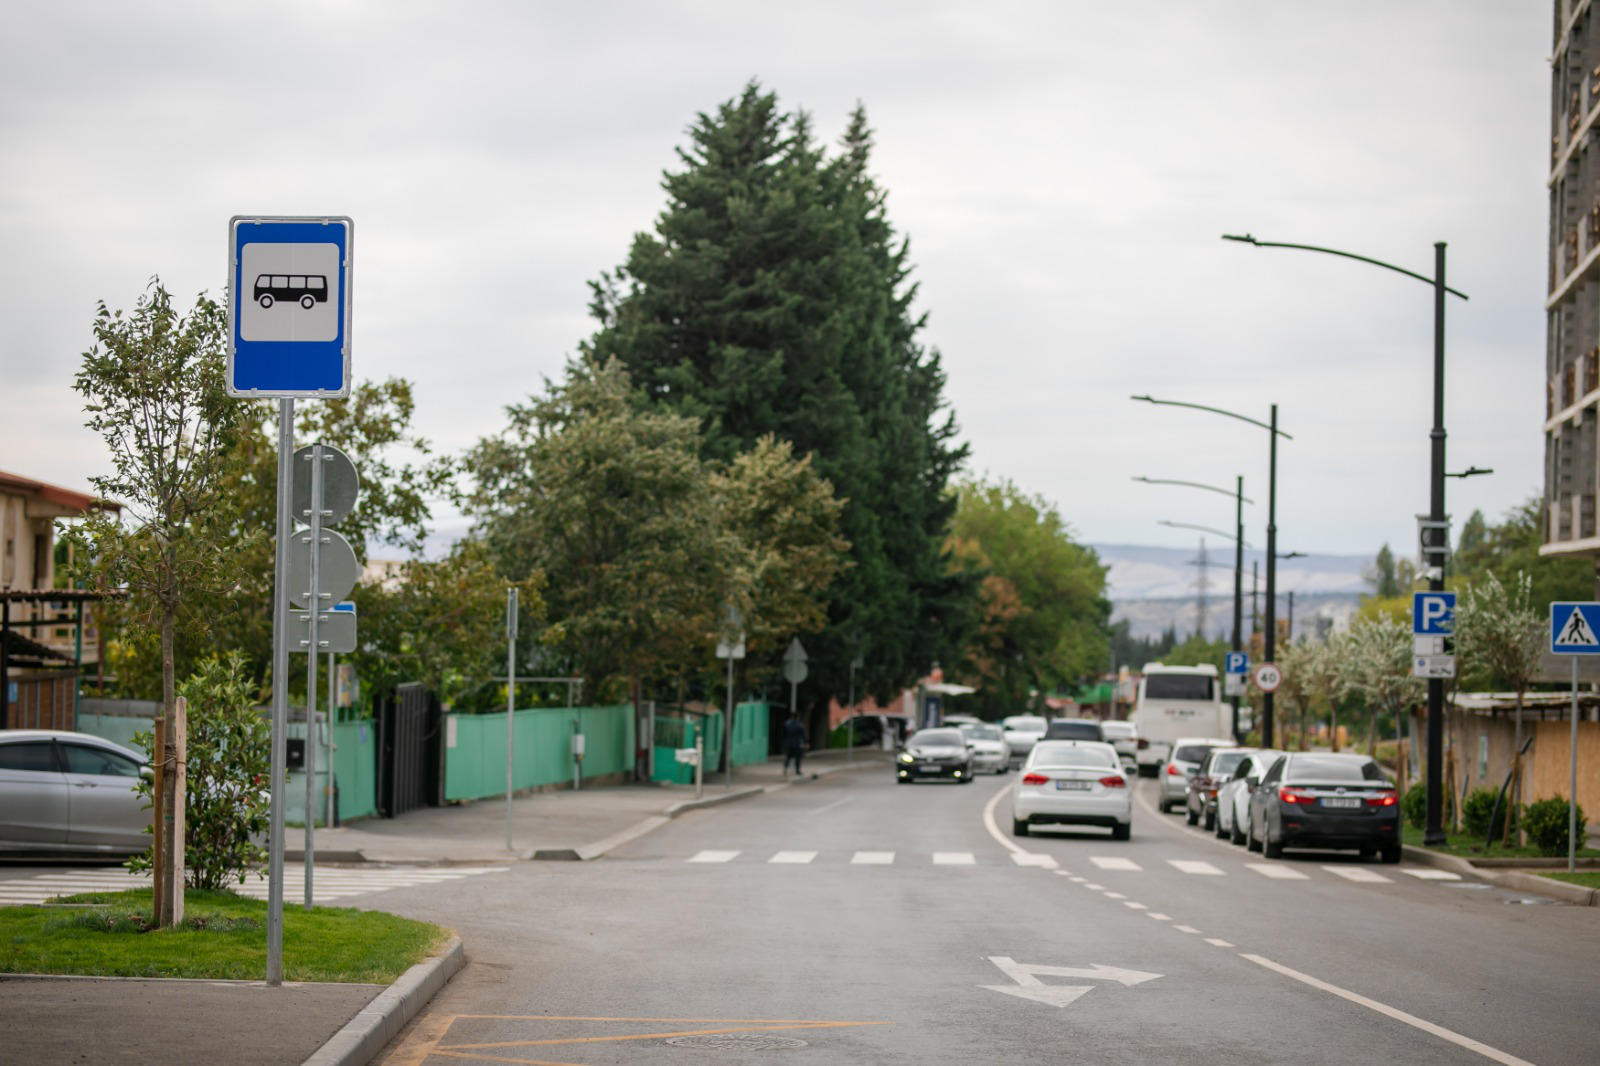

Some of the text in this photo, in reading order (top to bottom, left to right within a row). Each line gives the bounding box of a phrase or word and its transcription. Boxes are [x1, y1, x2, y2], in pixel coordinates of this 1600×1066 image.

[1423, 597, 1447, 630] P
[1230, 654, 1244, 672] P
[1261, 672, 1277, 683] 40
